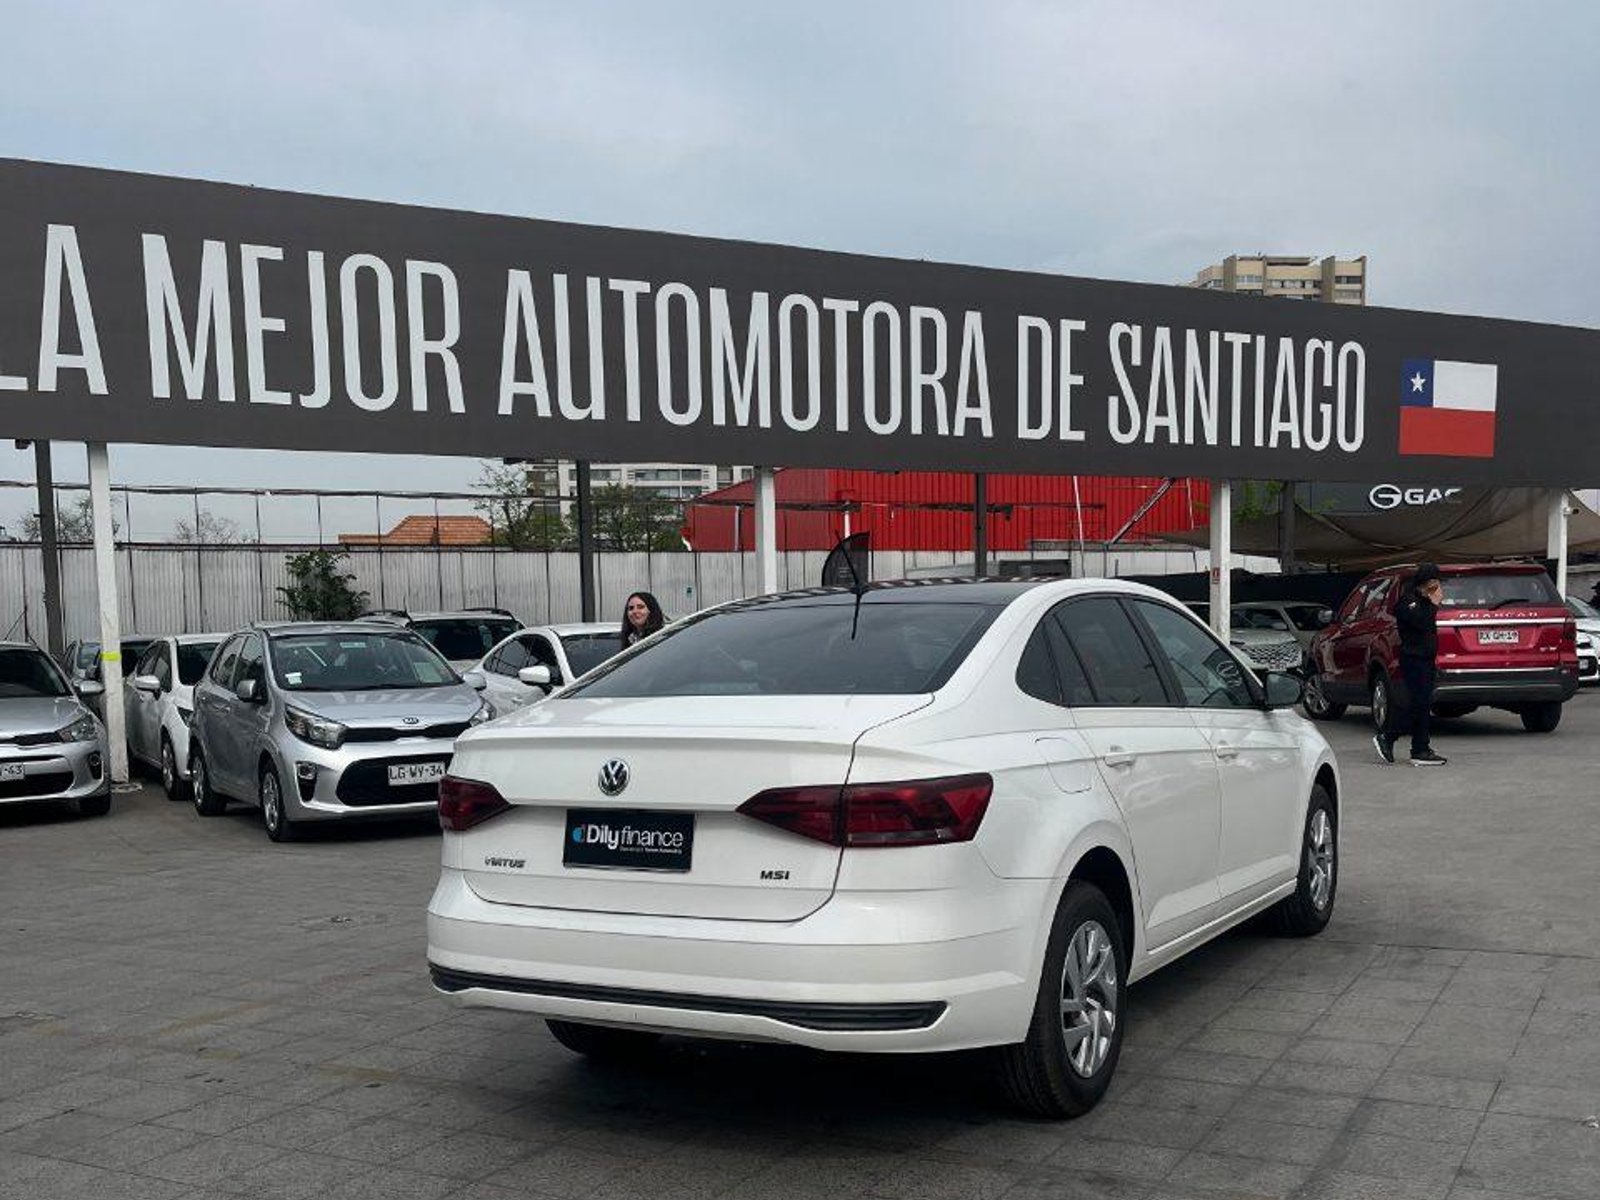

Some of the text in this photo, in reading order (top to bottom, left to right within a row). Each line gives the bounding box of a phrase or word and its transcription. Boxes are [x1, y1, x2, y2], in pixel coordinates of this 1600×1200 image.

[0, 223, 1367, 453] A MEJOR AUTOMOTORA DE SANTIAGO
[586, 825, 684, 849] Dily finance
